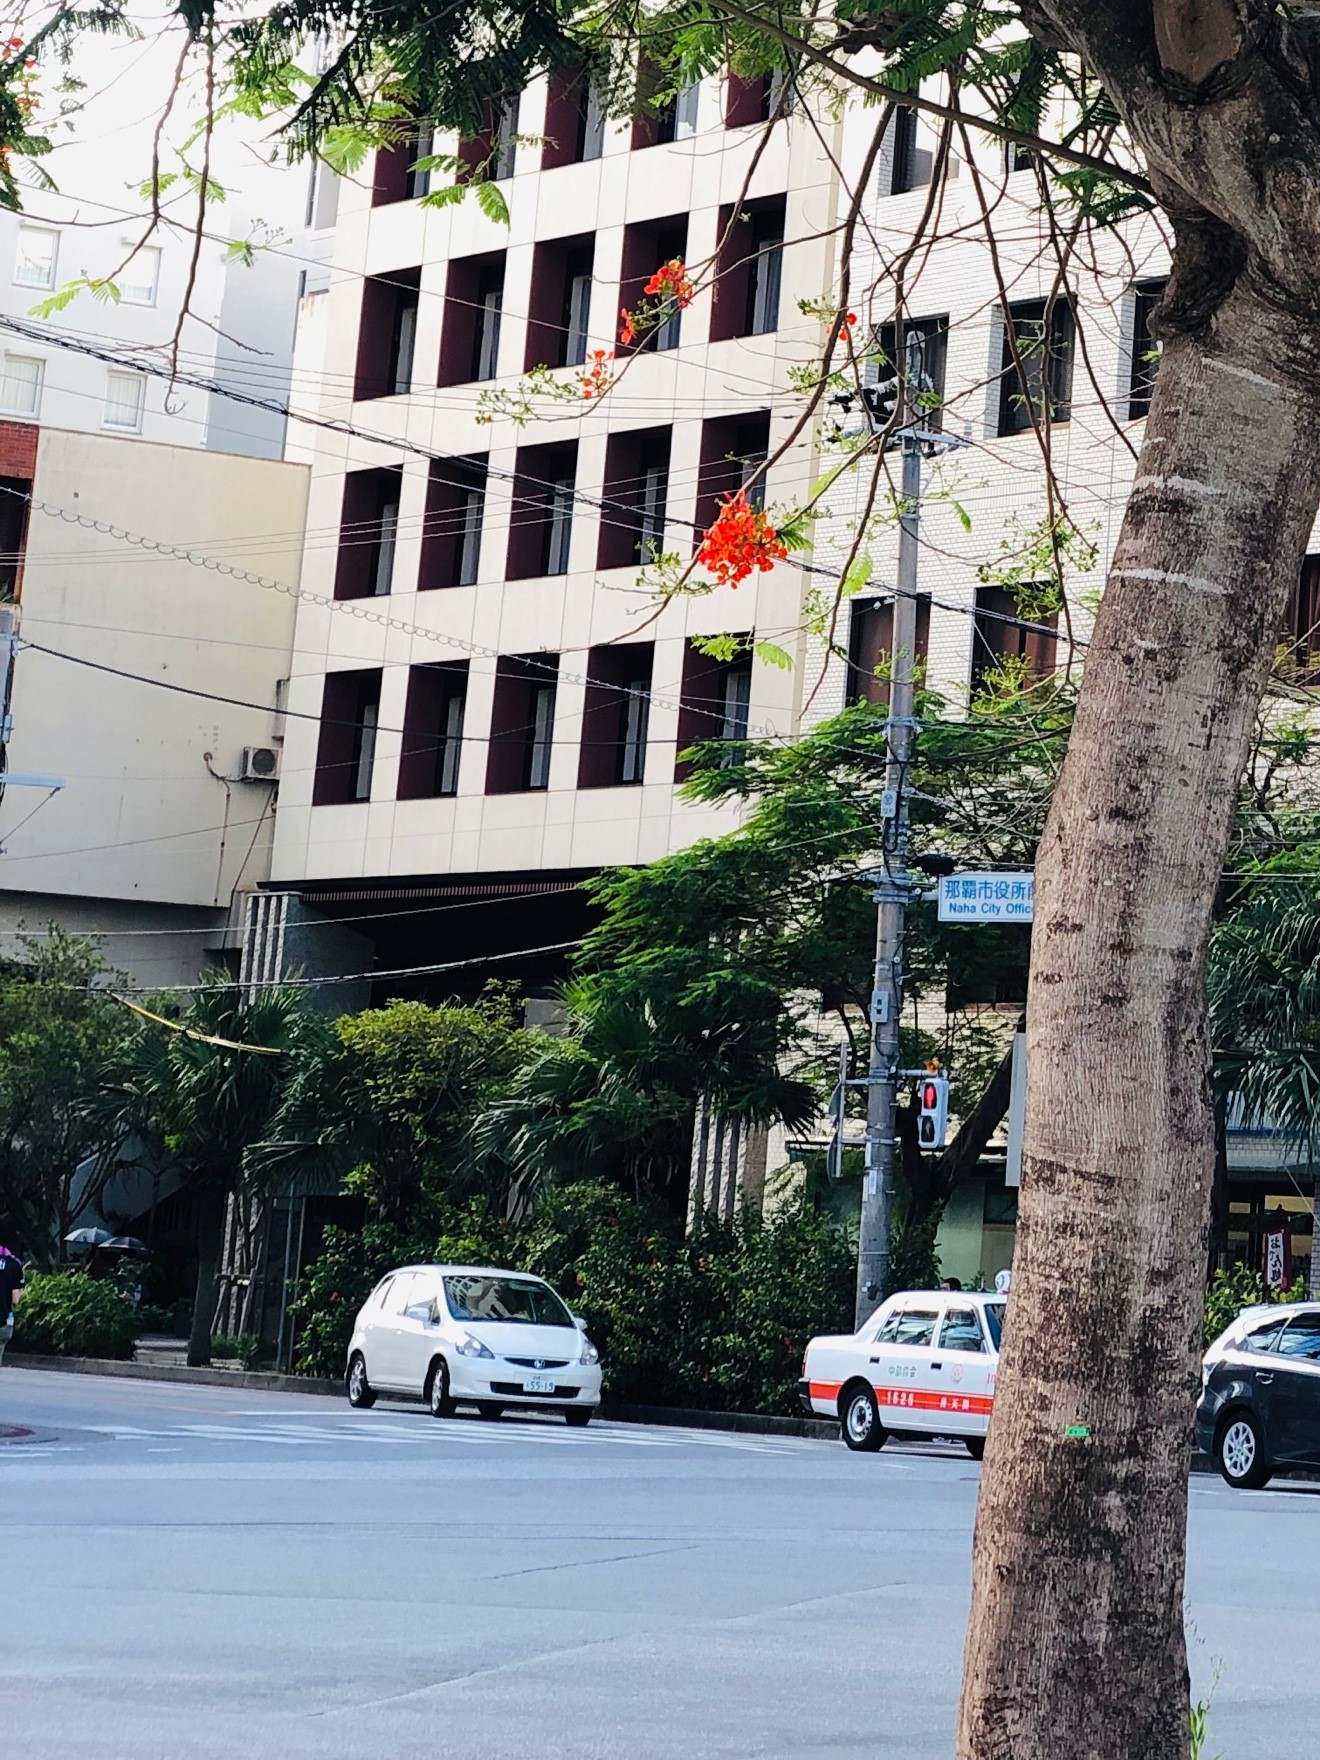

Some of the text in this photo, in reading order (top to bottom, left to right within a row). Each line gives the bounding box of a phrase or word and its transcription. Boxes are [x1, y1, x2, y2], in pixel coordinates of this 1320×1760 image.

[949, 902, 1034, 916] Naha City Offic
